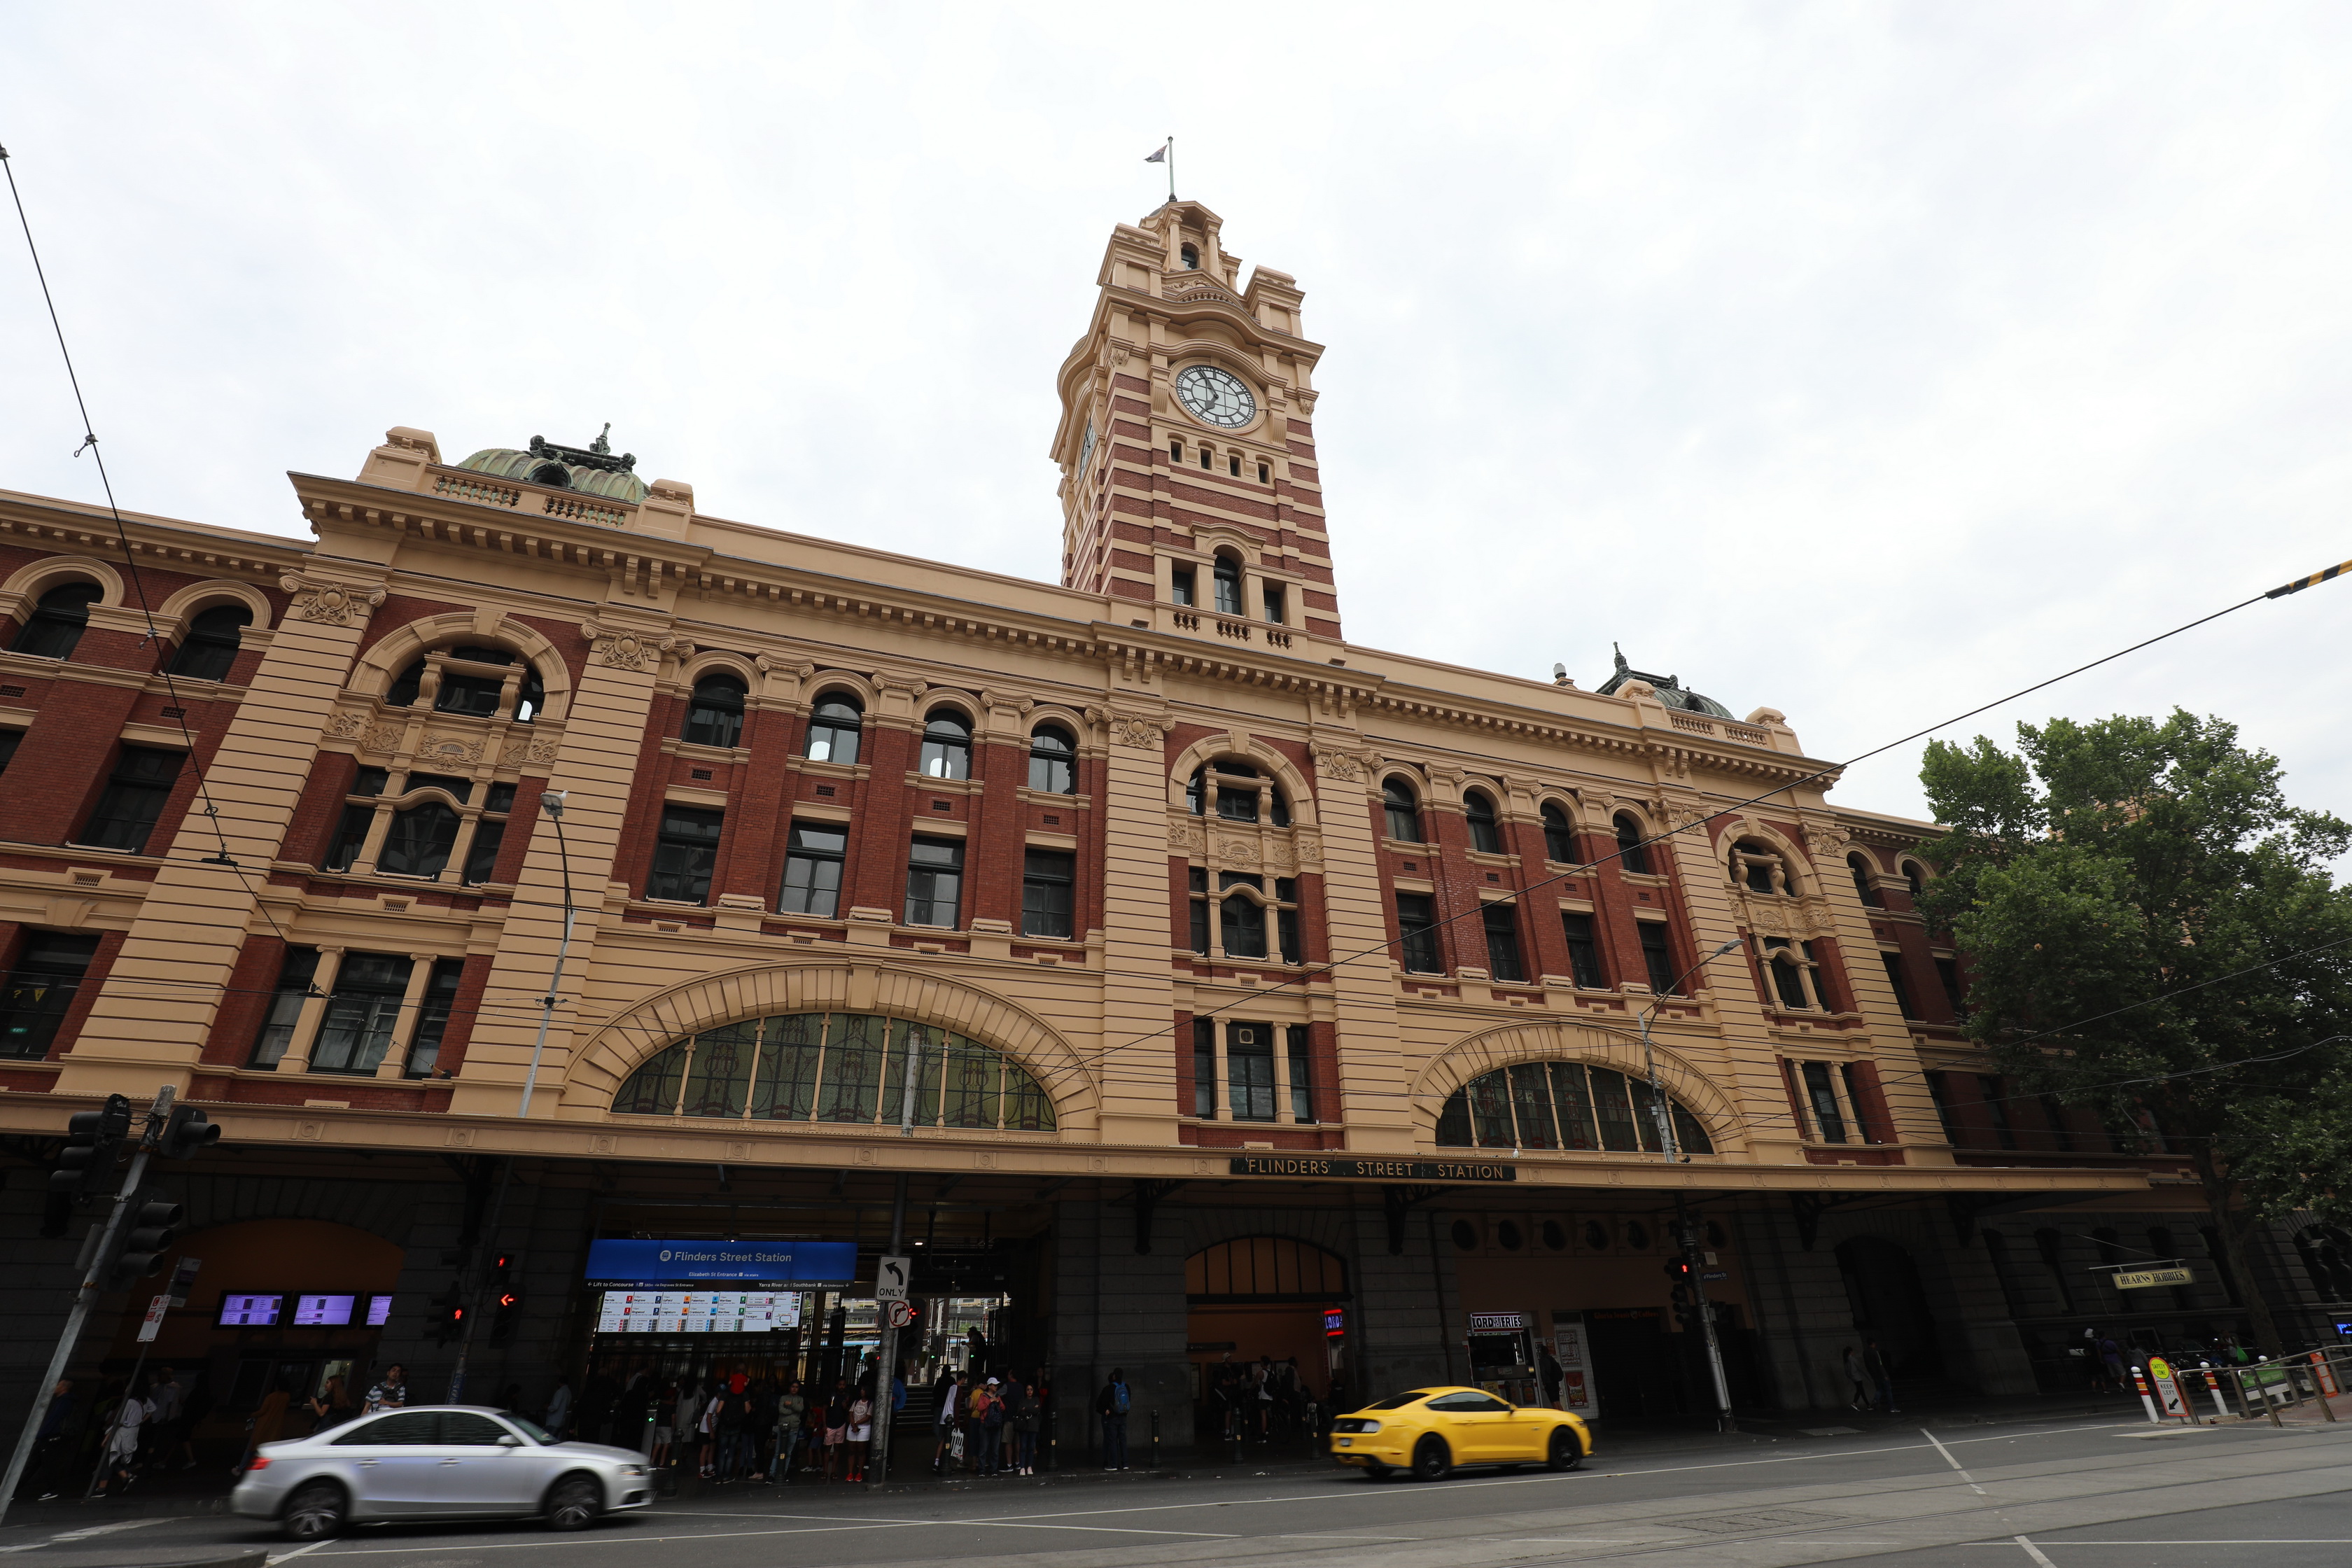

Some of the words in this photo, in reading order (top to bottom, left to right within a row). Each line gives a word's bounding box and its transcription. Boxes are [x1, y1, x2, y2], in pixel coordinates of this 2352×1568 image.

[1249, 1159, 1329, 1174] FLINDERS
[1357, 1161, 1413, 1176] STREET
[1437, 1164, 1503, 1179] STATION
[674, 1252, 717, 1261] Flinders
[720, 1252, 752, 1261] Street
[755, 1252, 792, 1262] Station
[2120, 1273, 2151, 1285] HEARNS
[2152, 1270, 2185, 1282] HOBBIES
[879, 1288, 904, 1296] ONLY
[1324, 1315, 1339, 1329] LORD
[1472, 1317, 1494, 1328] LORD
[1501, 1316, 1522, 1328] FRIES
